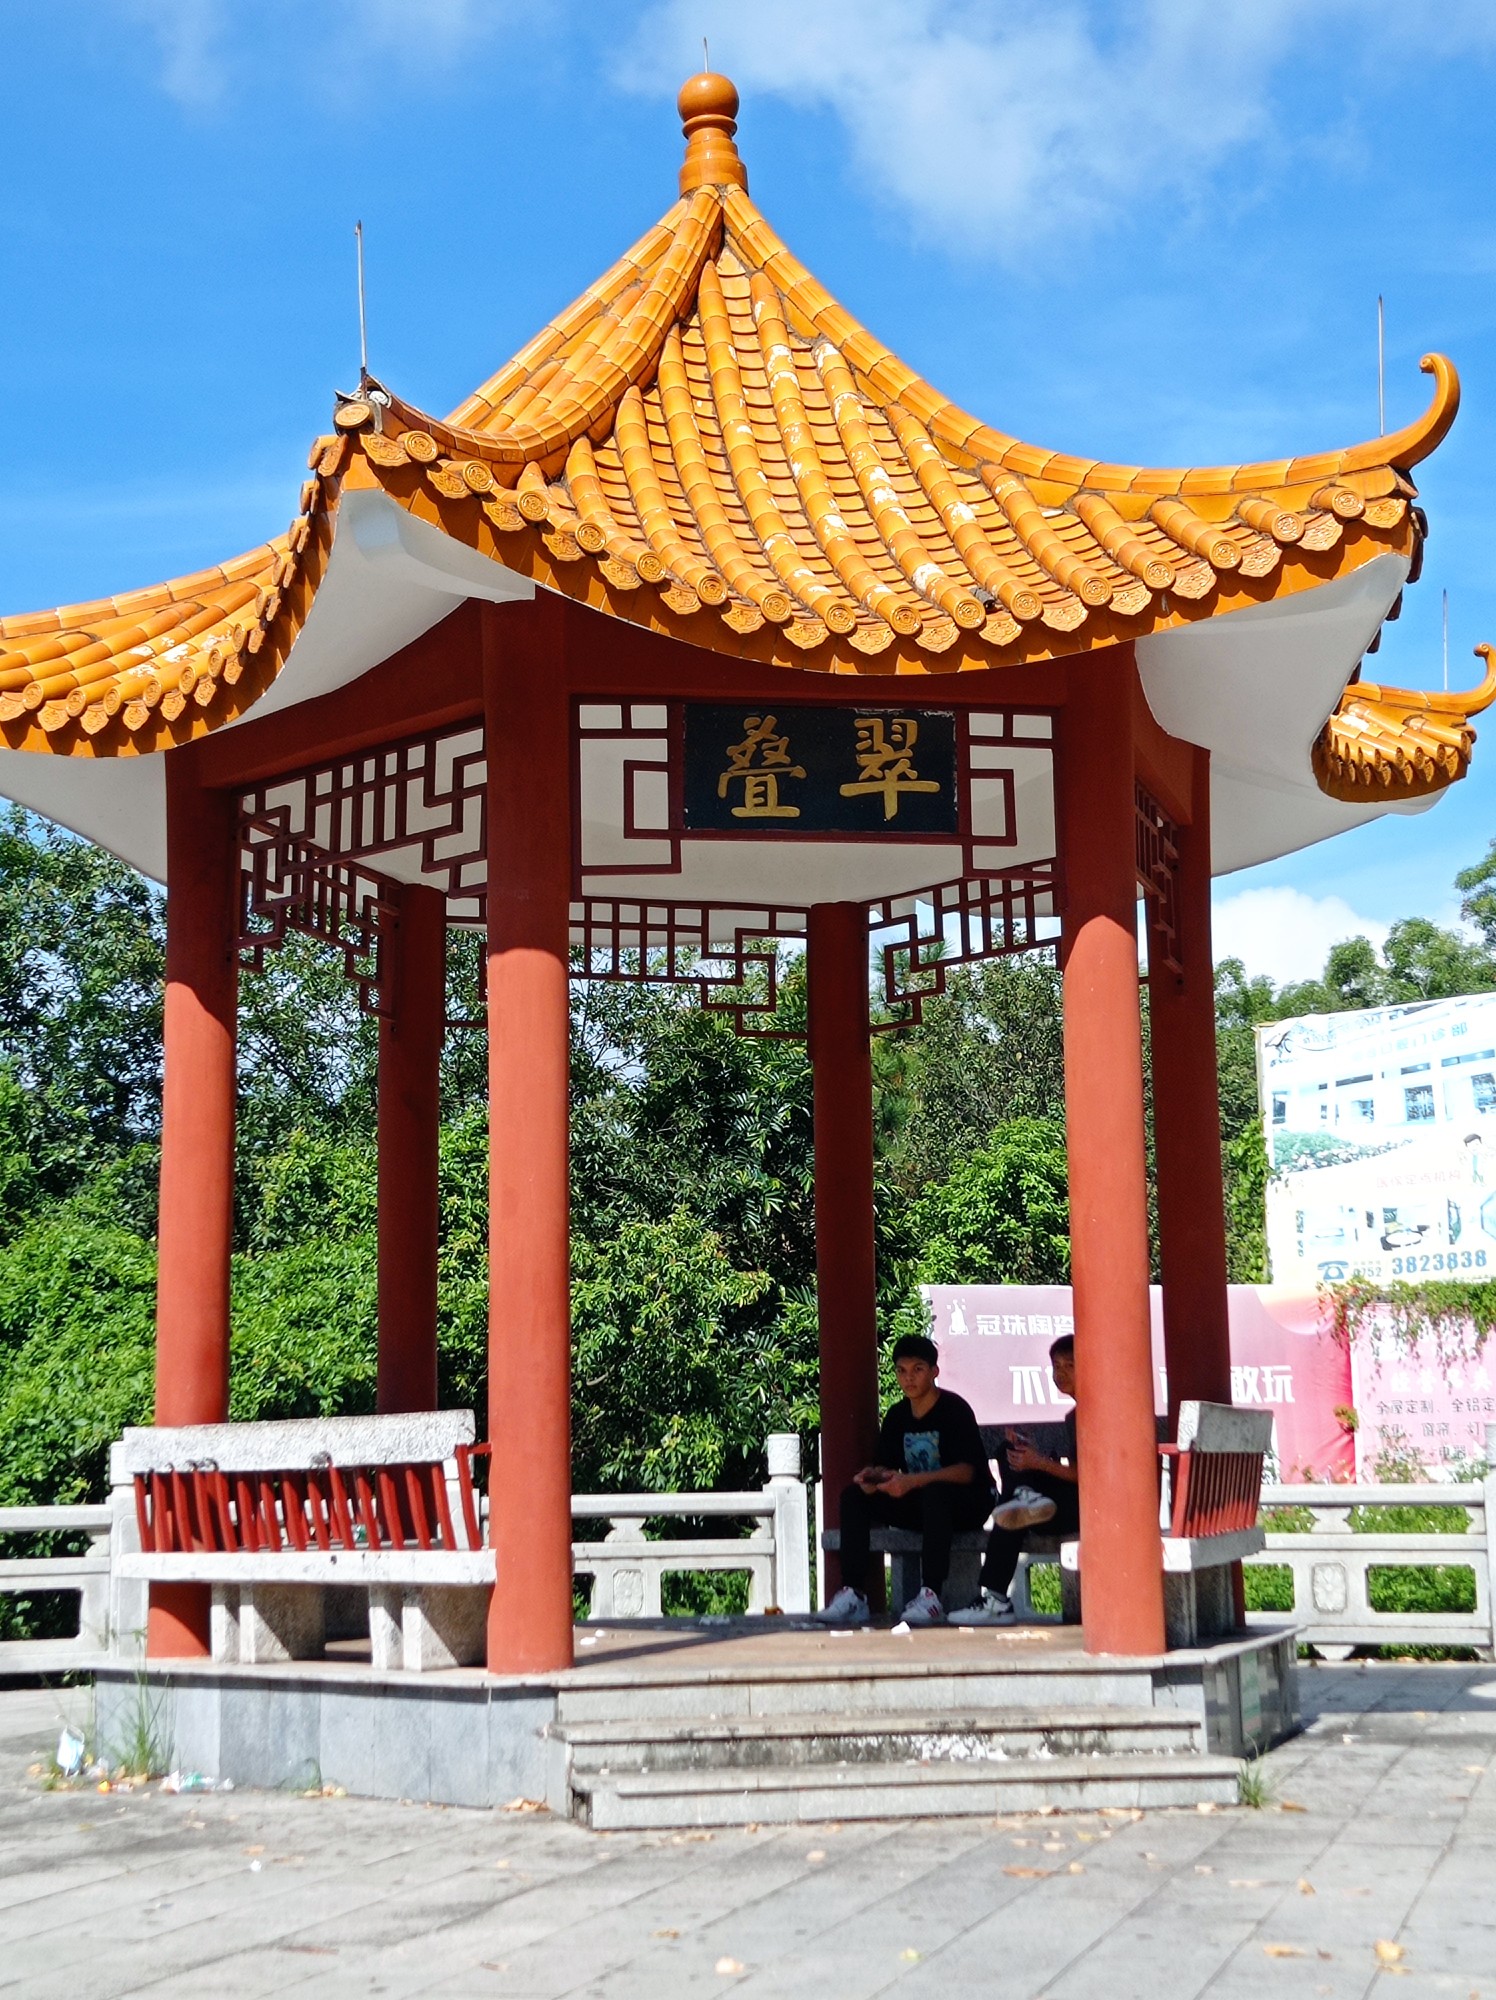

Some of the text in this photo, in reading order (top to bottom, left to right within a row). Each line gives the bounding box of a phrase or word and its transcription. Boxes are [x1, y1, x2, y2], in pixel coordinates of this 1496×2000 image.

[1392, 1249, 1487, 1275] 3823838
[976, 1314, 1075, 1336] 冠珠陶瓷
